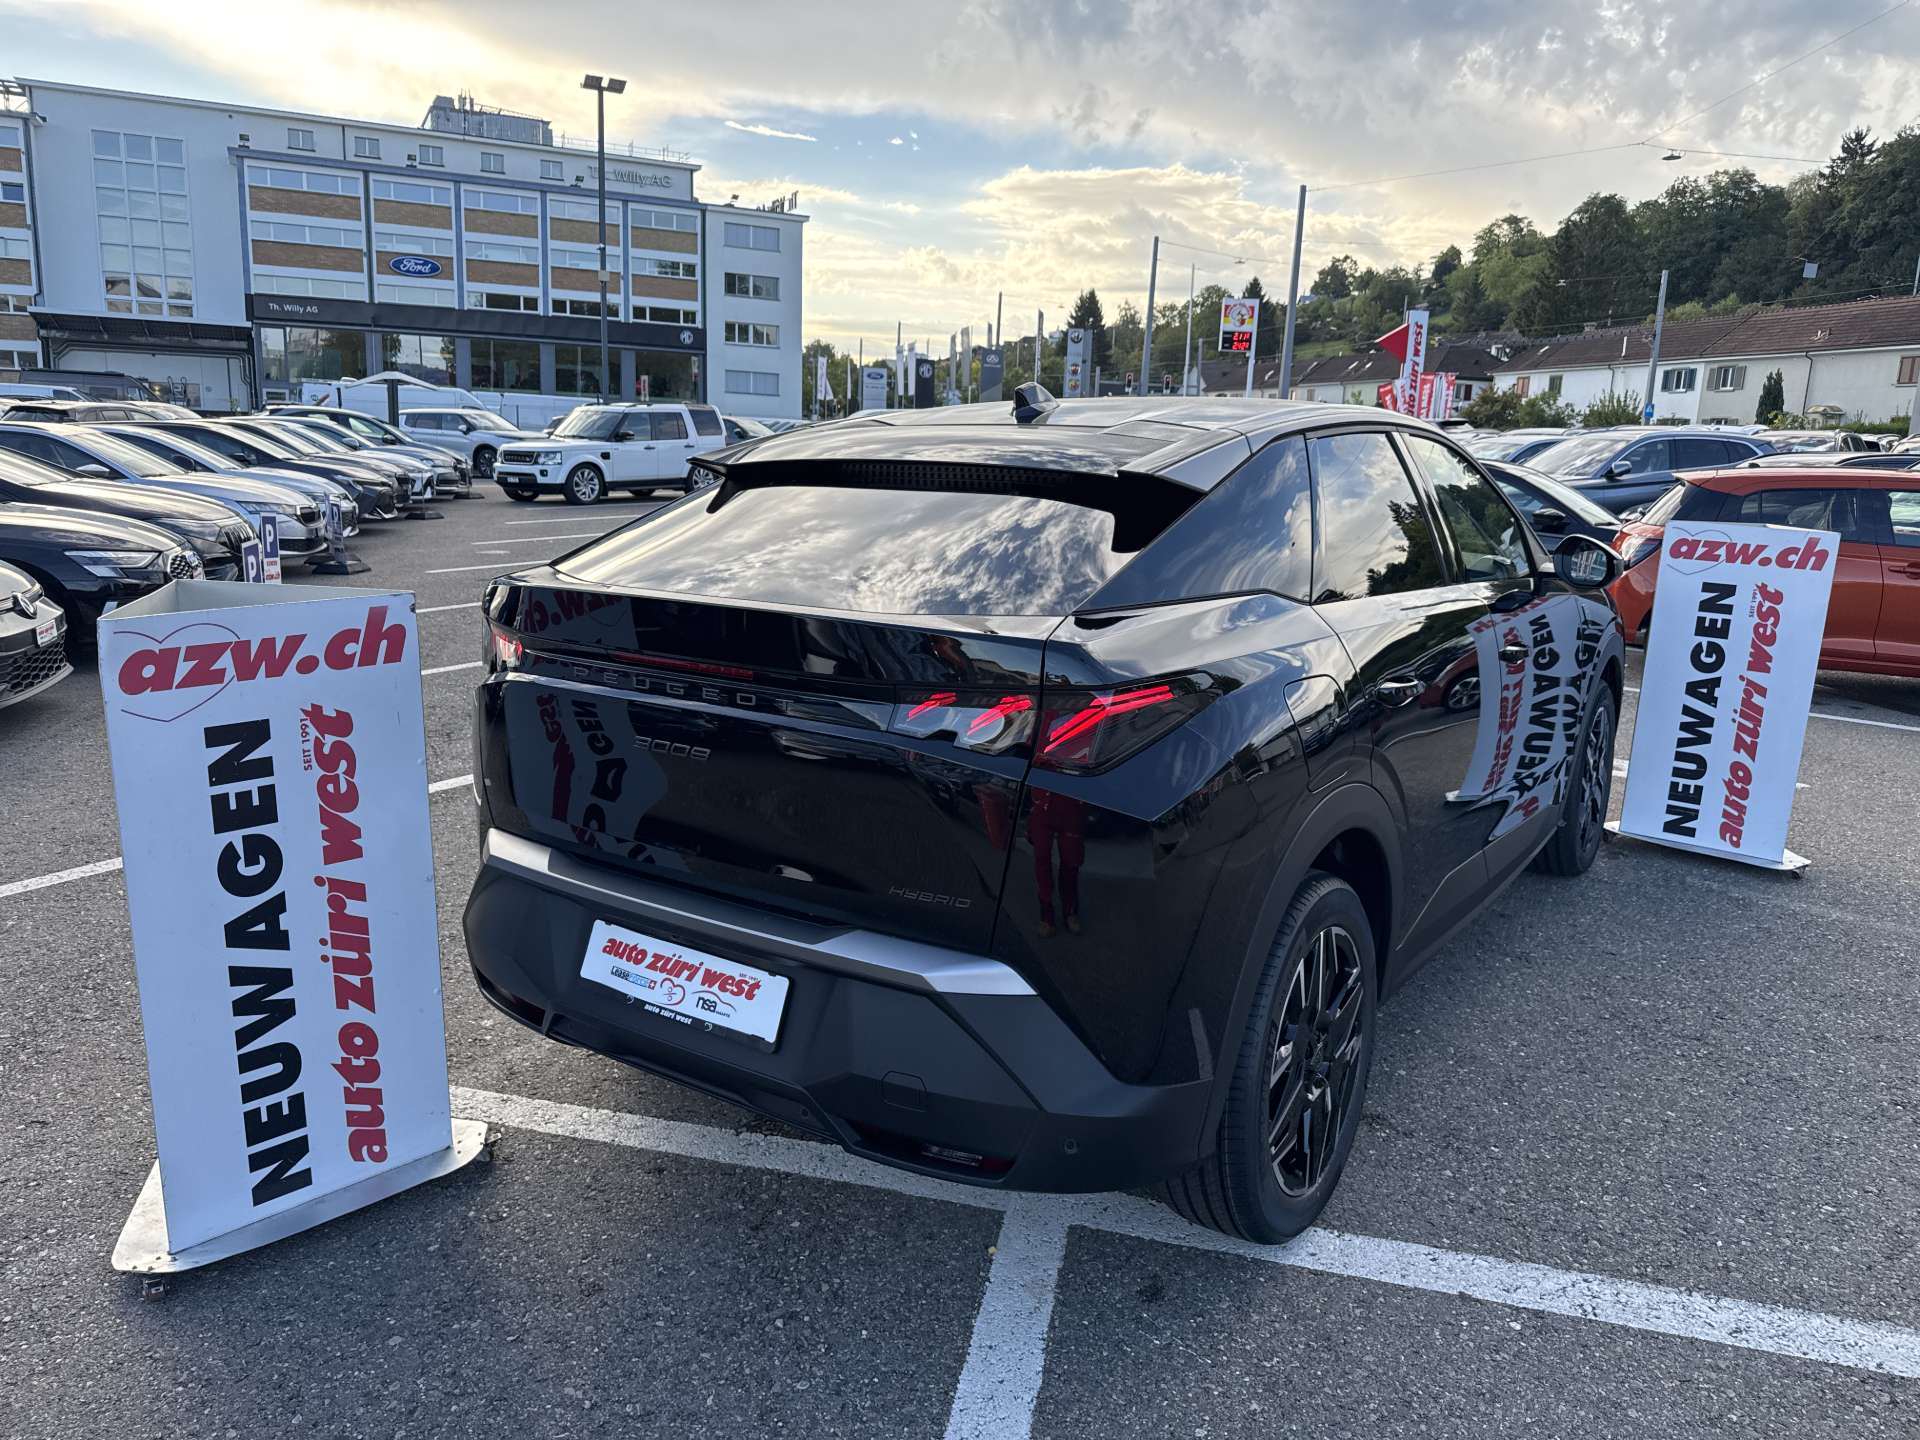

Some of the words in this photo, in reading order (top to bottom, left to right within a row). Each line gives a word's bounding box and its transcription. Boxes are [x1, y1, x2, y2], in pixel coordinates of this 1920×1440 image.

[283, 304, 304, 314] Willy
[305, 306, 319, 314] AG
[1412, 320, 1424, 358] west
[265, 523, 274, 553] P
[1668, 537, 1830, 572] azw.ch
[247, 555, 257, 583] P
[1747, 582, 1785, 675] west
[118, 606, 407, 696] azw.ch
[573, 666, 795, 714] PEUGEOT
[1662, 581, 1738, 839] NEUWAGEN
[299, 717, 311, 745] 1991
[1731, 675, 1768, 764] züri
[302, 747, 313, 771] SEIT
[633, 735, 712, 760] 3008
[299, 703, 363, 866] west
[1718, 759, 1754, 849] auto
[888, 886, 971, 908] HYBRID
[204, 718, 313, 1208] NEUWAGEN
[317, 874, 373, 1014] züri
[602, 937, 648, 966] auto
[645, 953, 704, 983] züri
[701, 967, 762, 1001] west
[643, 1003, 661, 1014] auto
[675, 1011, 693, 1025] west
[696, 996, 718, 1014] nsa
[330, 1022, 388, 1164] auto
